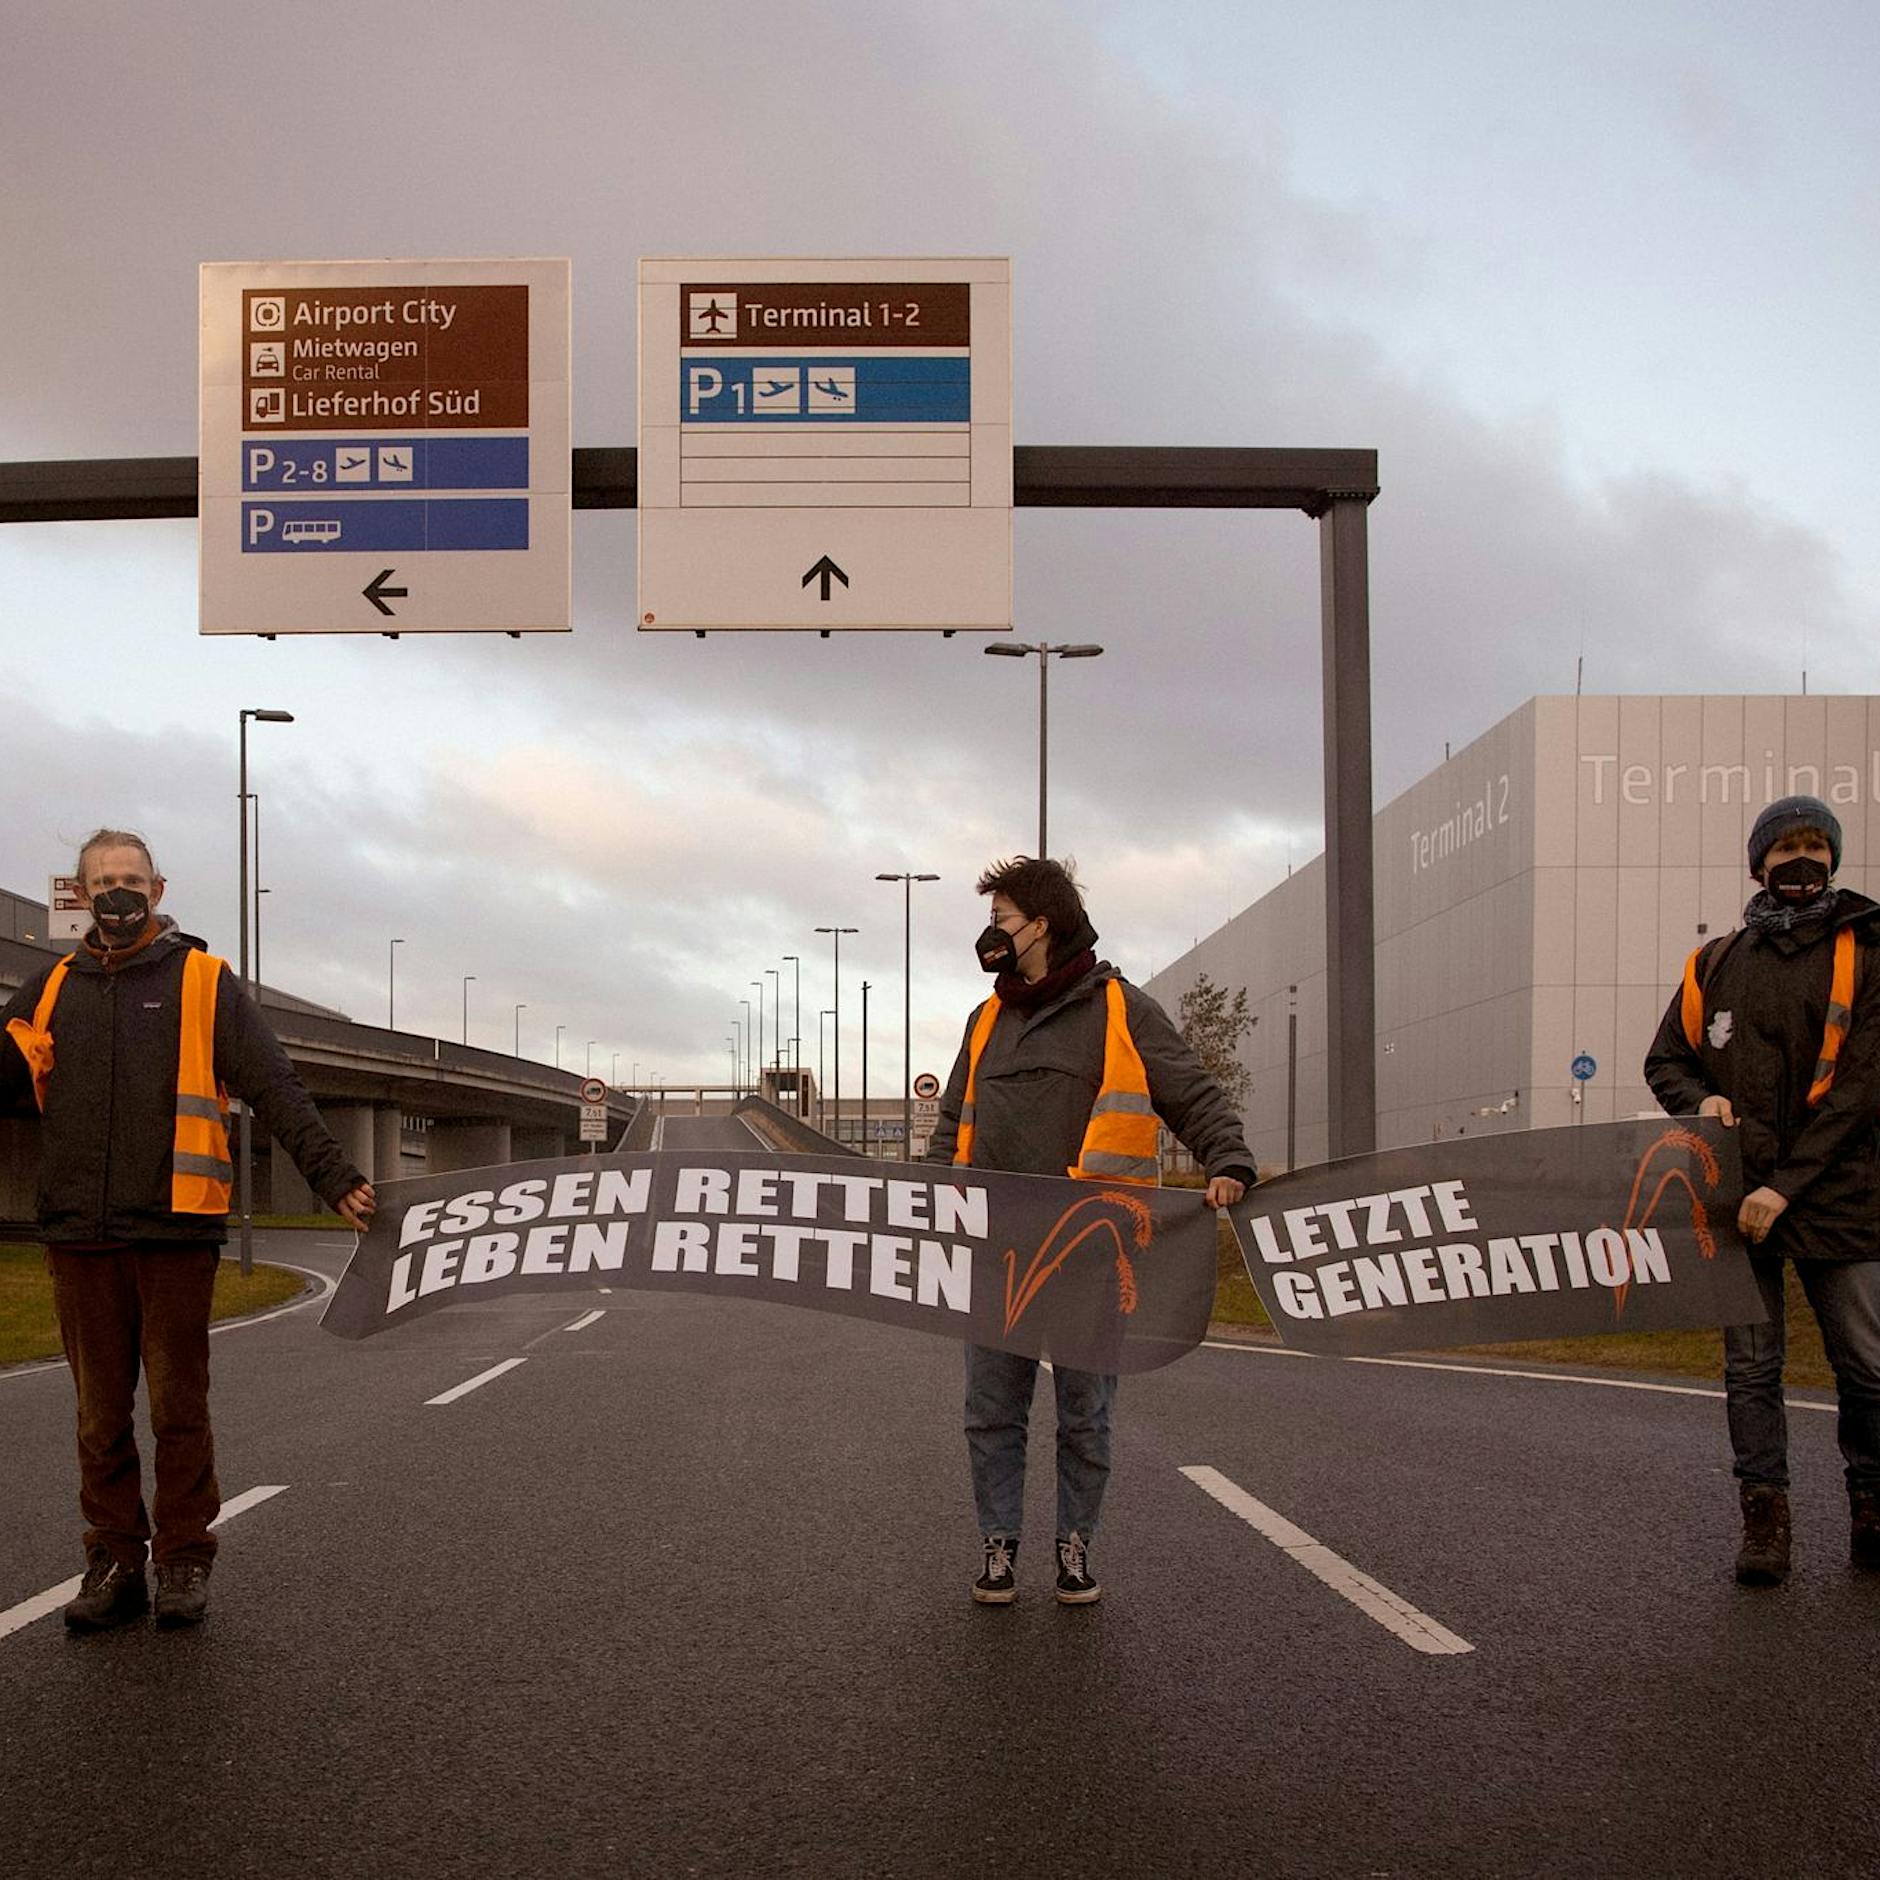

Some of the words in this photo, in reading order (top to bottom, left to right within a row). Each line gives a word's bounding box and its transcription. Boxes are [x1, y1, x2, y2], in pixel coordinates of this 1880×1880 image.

[293, 300, 395, 330] Airport
[402, 299, 457, 330] City
[745, 302, 872, 327] Terminal
[879, 303, 921, 327] 1-2
[293, 339, 418, 361] Mietwagen
[292, 365, 319, 382] Car
[325, 363, 380, 381] Rental
[292, 391, 421, 417] Lieferhof
[428, 390, 481, 416] Süd
[689, 367, 723, 414] P
[731, 382, 746, 415] 1
[249, 449, 275, 482] P
[282, 461, 328, 483] 2-8
[249, 510, 275, 544] P
[1410, 785, 1493, 875] Terminal
[1498, 774, 1510, 824] 2
[398, 1168, 653, 1249] ESSEN
[674, 1168, 989, 1239] RETTEN
[1249, 1179, 1479, 1264] LETZTE
[386, 1221, 629, 1314] LEBEN
[651, 1220, 974, 1314] RETTEN
[1272, 1226, 1671, 1320] GENERATION
